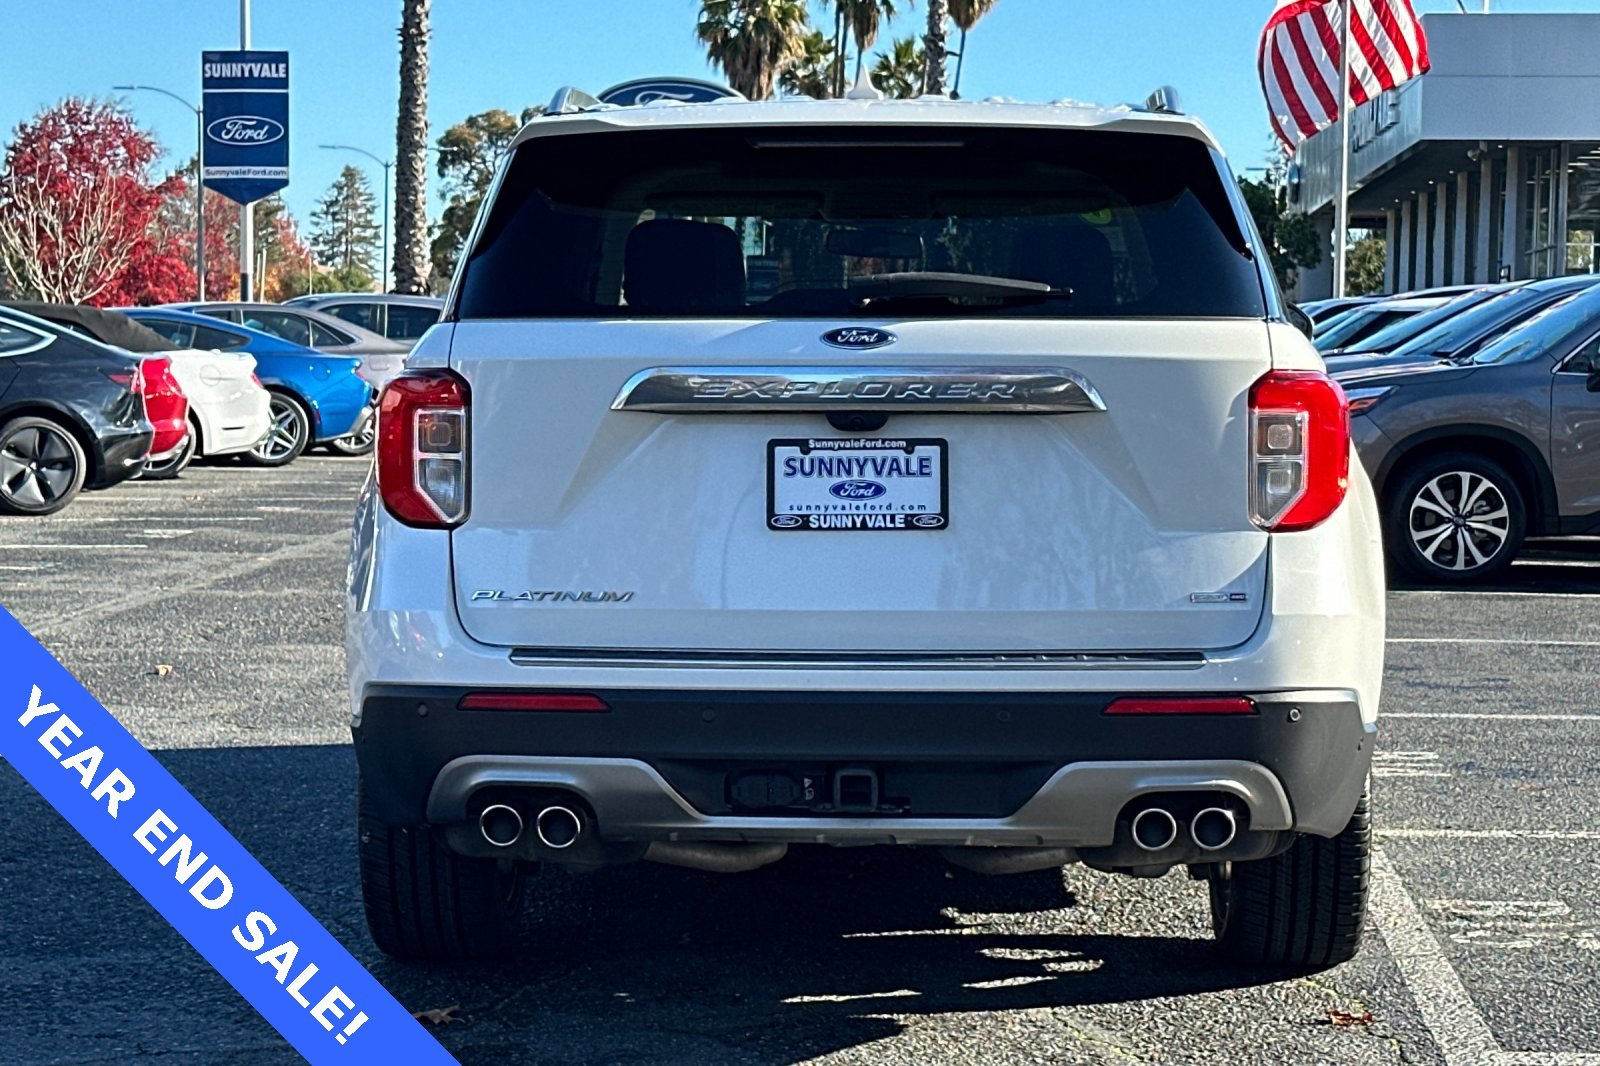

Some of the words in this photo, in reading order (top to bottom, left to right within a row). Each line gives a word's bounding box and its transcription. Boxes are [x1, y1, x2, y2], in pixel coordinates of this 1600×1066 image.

[204, 63, 287, 78] SUNNYVALE
[221, 119, 270, 141] Ford
[205, 168, 287, 177] SunnyvaleFord.com
[693, 381, 1017, 400] EXPLORER
[808, 439, 907, 449] SunnyvaleFord.com
[784, 456, 932, 478] SUNNYVALE
[840, 481, 875, 498] Ford
[789, 502, 927, 513] sunnyvaleford.com
[808, 515, 906, 528] SUNNYVALE
[471, 590, 635, 603] PLATINUM
